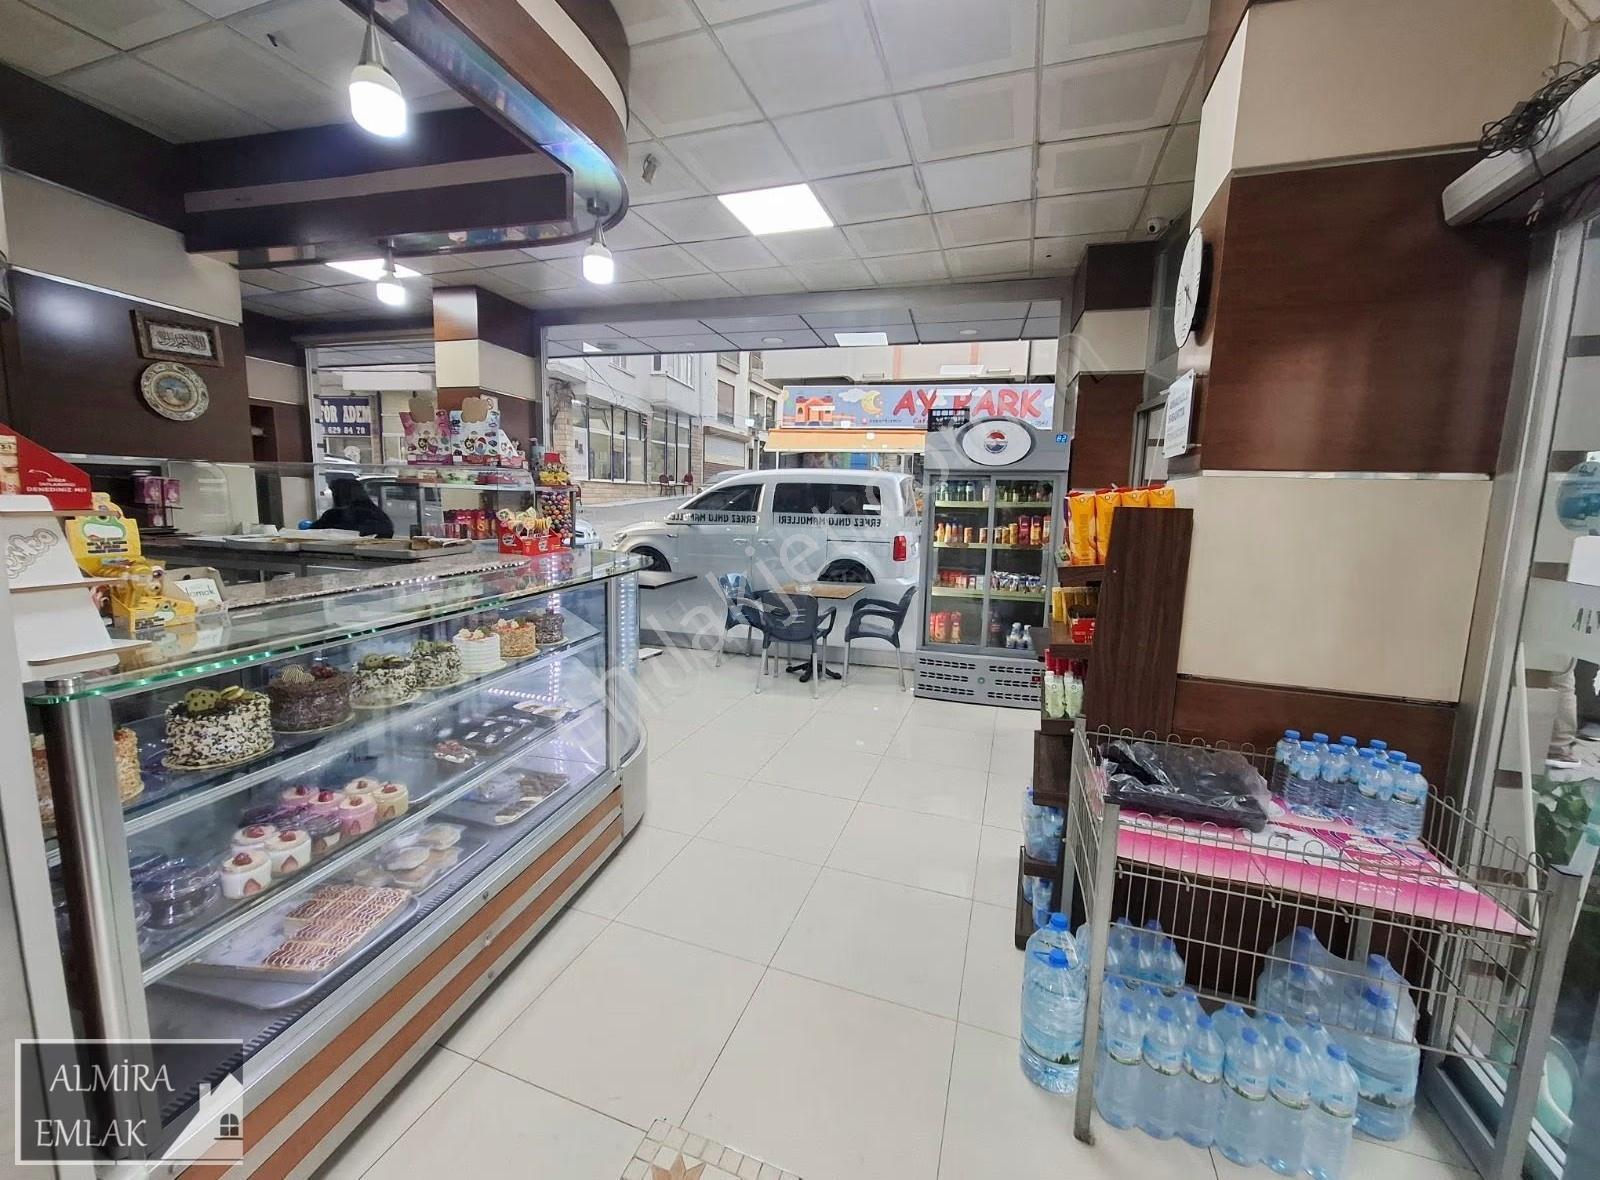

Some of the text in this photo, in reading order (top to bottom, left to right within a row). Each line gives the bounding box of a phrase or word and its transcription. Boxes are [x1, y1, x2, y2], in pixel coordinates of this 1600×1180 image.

[342, 405, 371, 423] ADEM
[893, 388, 1042, 418] AY PARK
